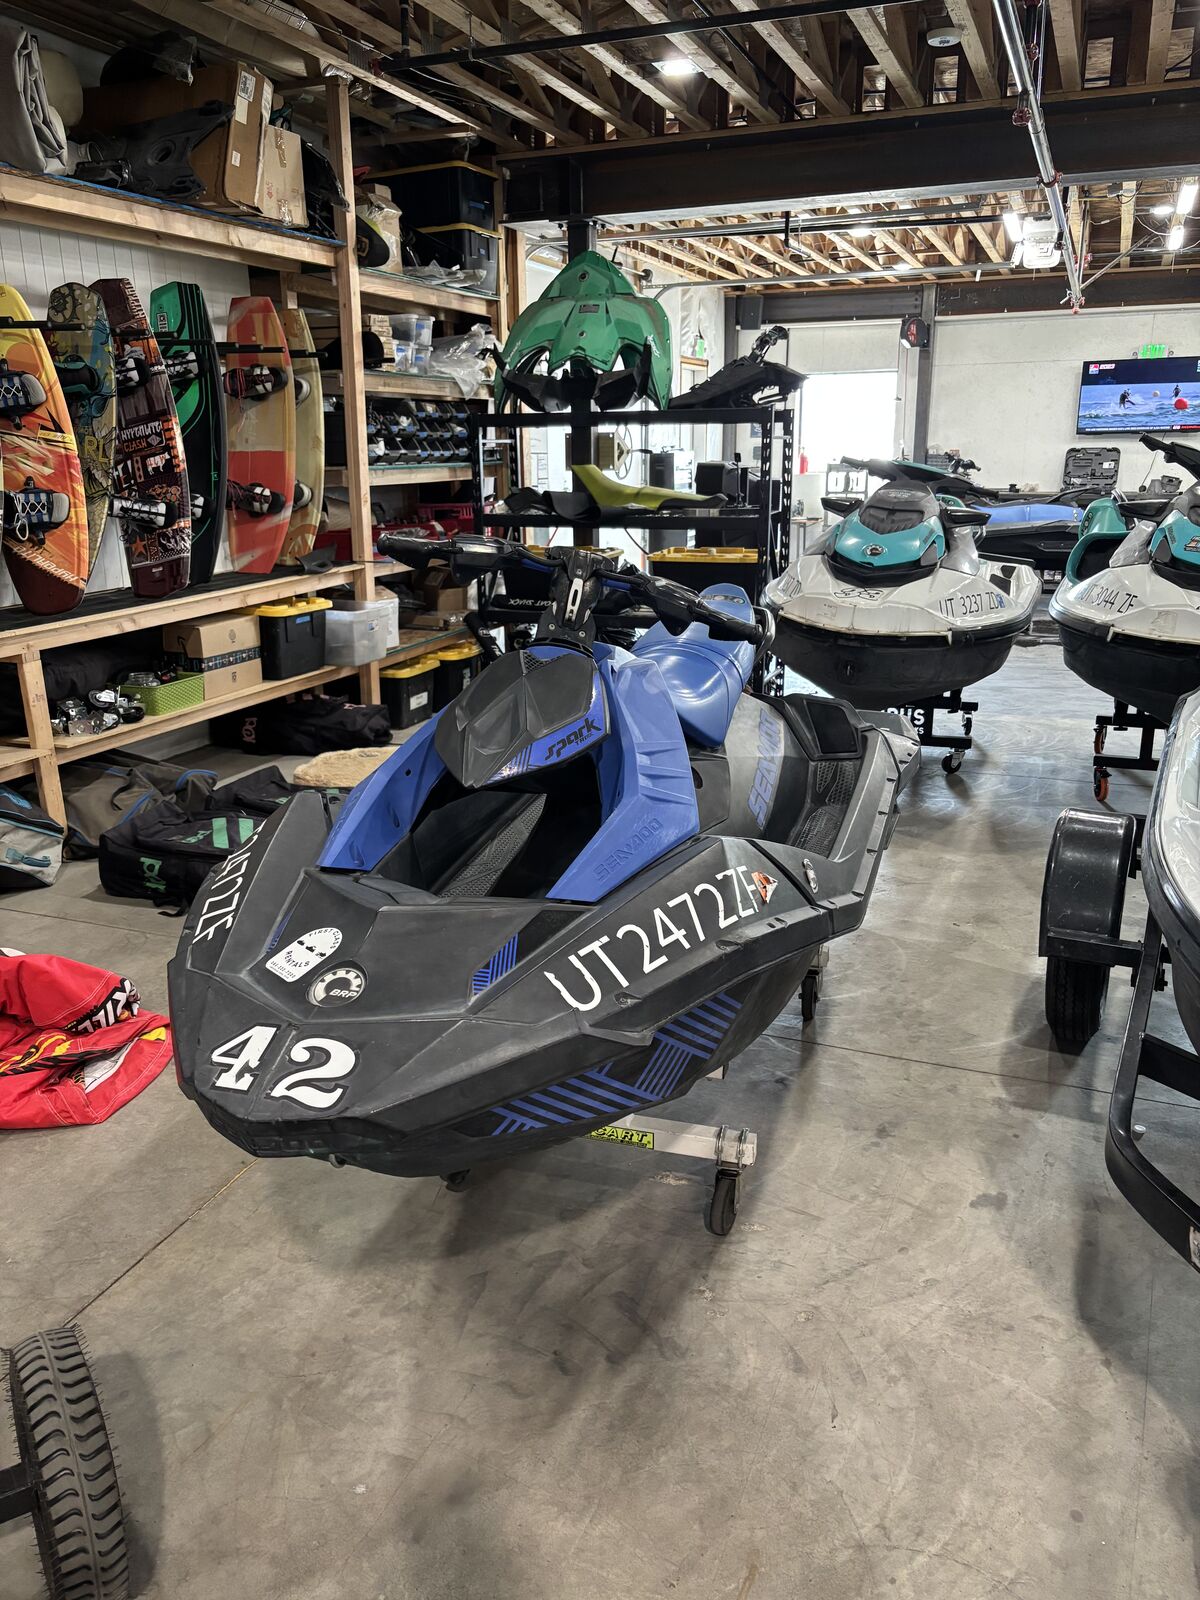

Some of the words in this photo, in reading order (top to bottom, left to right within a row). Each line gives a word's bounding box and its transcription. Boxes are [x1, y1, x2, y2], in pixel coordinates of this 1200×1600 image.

[123, 438, 148, 451] CLASH
[938, 598, 955, 618] UT
[959, 593, 984, 615] 3237
[1091, 586, 1120, 610] 3044
[1117, 593, 1138, 614] ZF
[308, 928, 334, 937] FIRST
[330, 930, 341, 950] CLASS
[285, 950, 310, 968] RENTALS
[329, 988, 358, 1000] BRP
